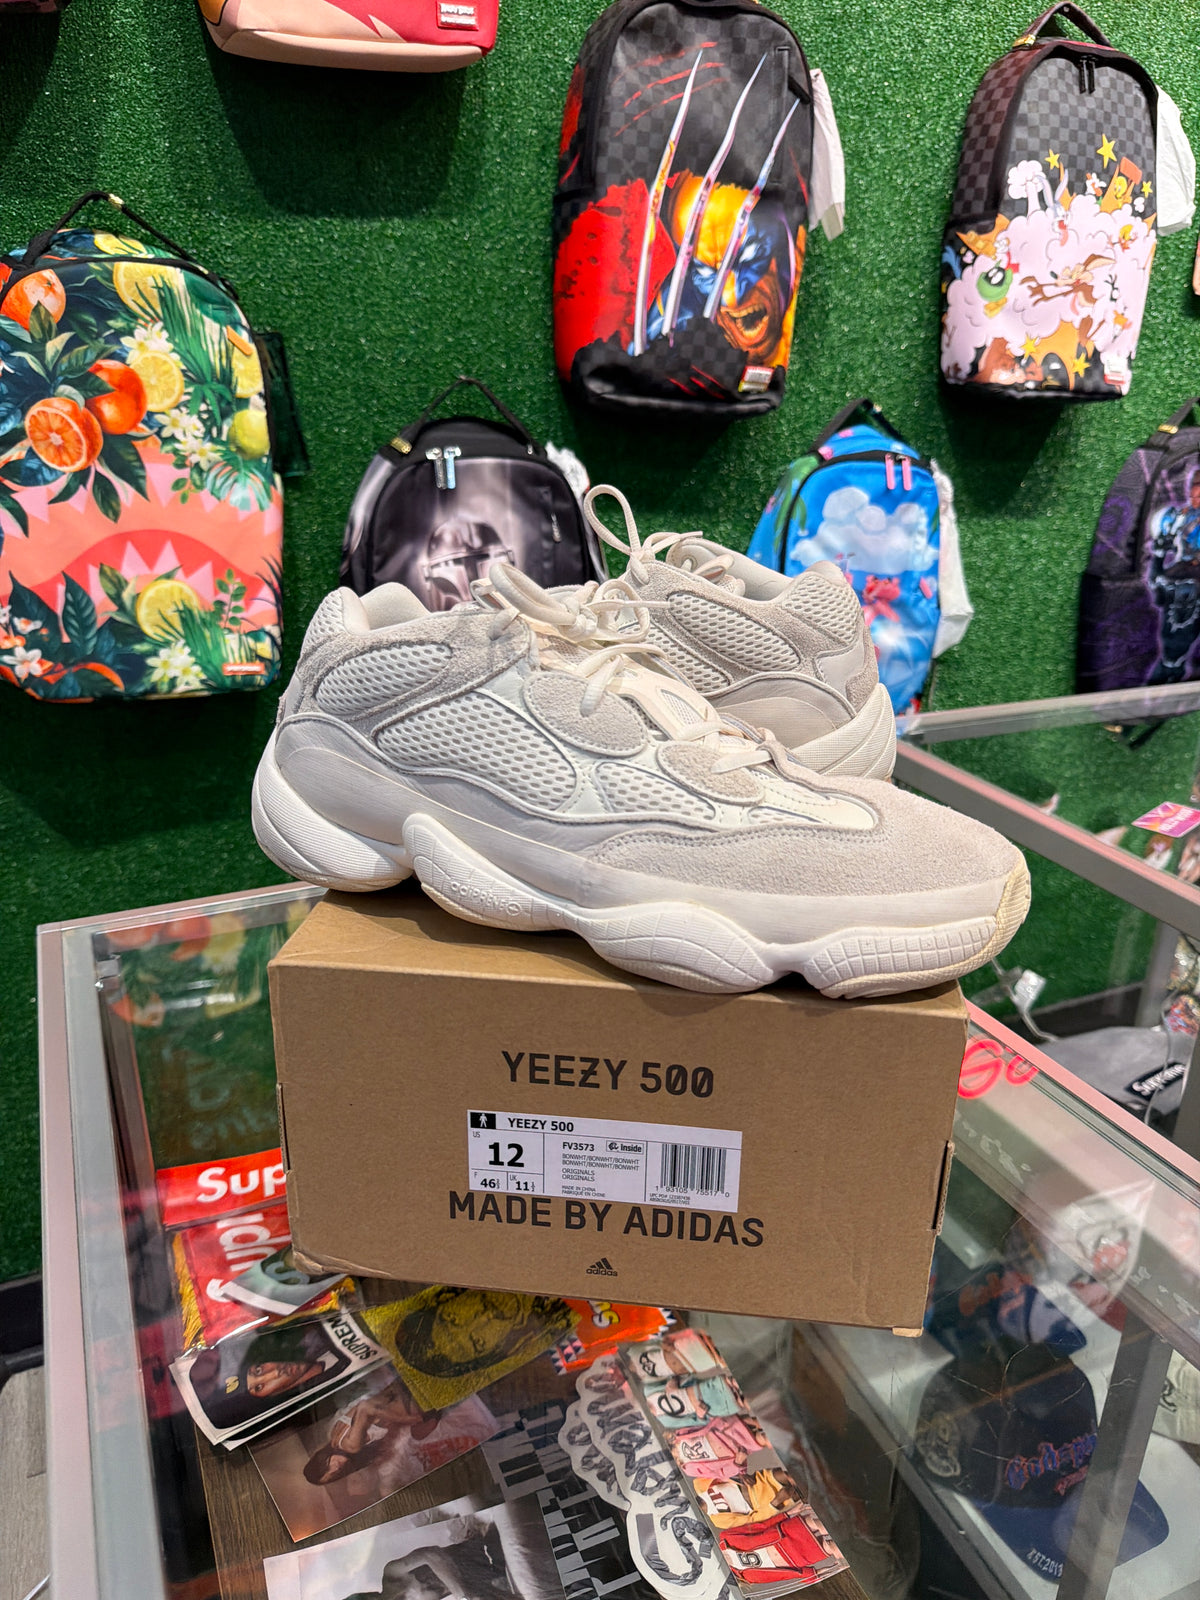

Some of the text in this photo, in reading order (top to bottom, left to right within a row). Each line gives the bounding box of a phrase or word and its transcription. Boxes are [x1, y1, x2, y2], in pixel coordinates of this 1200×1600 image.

[501, 1050, 715, 1098] YEEZY 500
[508, 1117, 574, 1132] YEEZY 500
[562, 1141, 595, 1152] FV3573
[620, 1143, 642, 1153] Inside
[488, 1141, 525, 1168] 12
[561, 1167, 595, 1176] ORIGINALS
[561, 1173, 595, 1182] ORIGINALS
[449, 1190, 765, 1247] MADE BY ADIDAS
[586, 1265, 618, 1277] adidas
